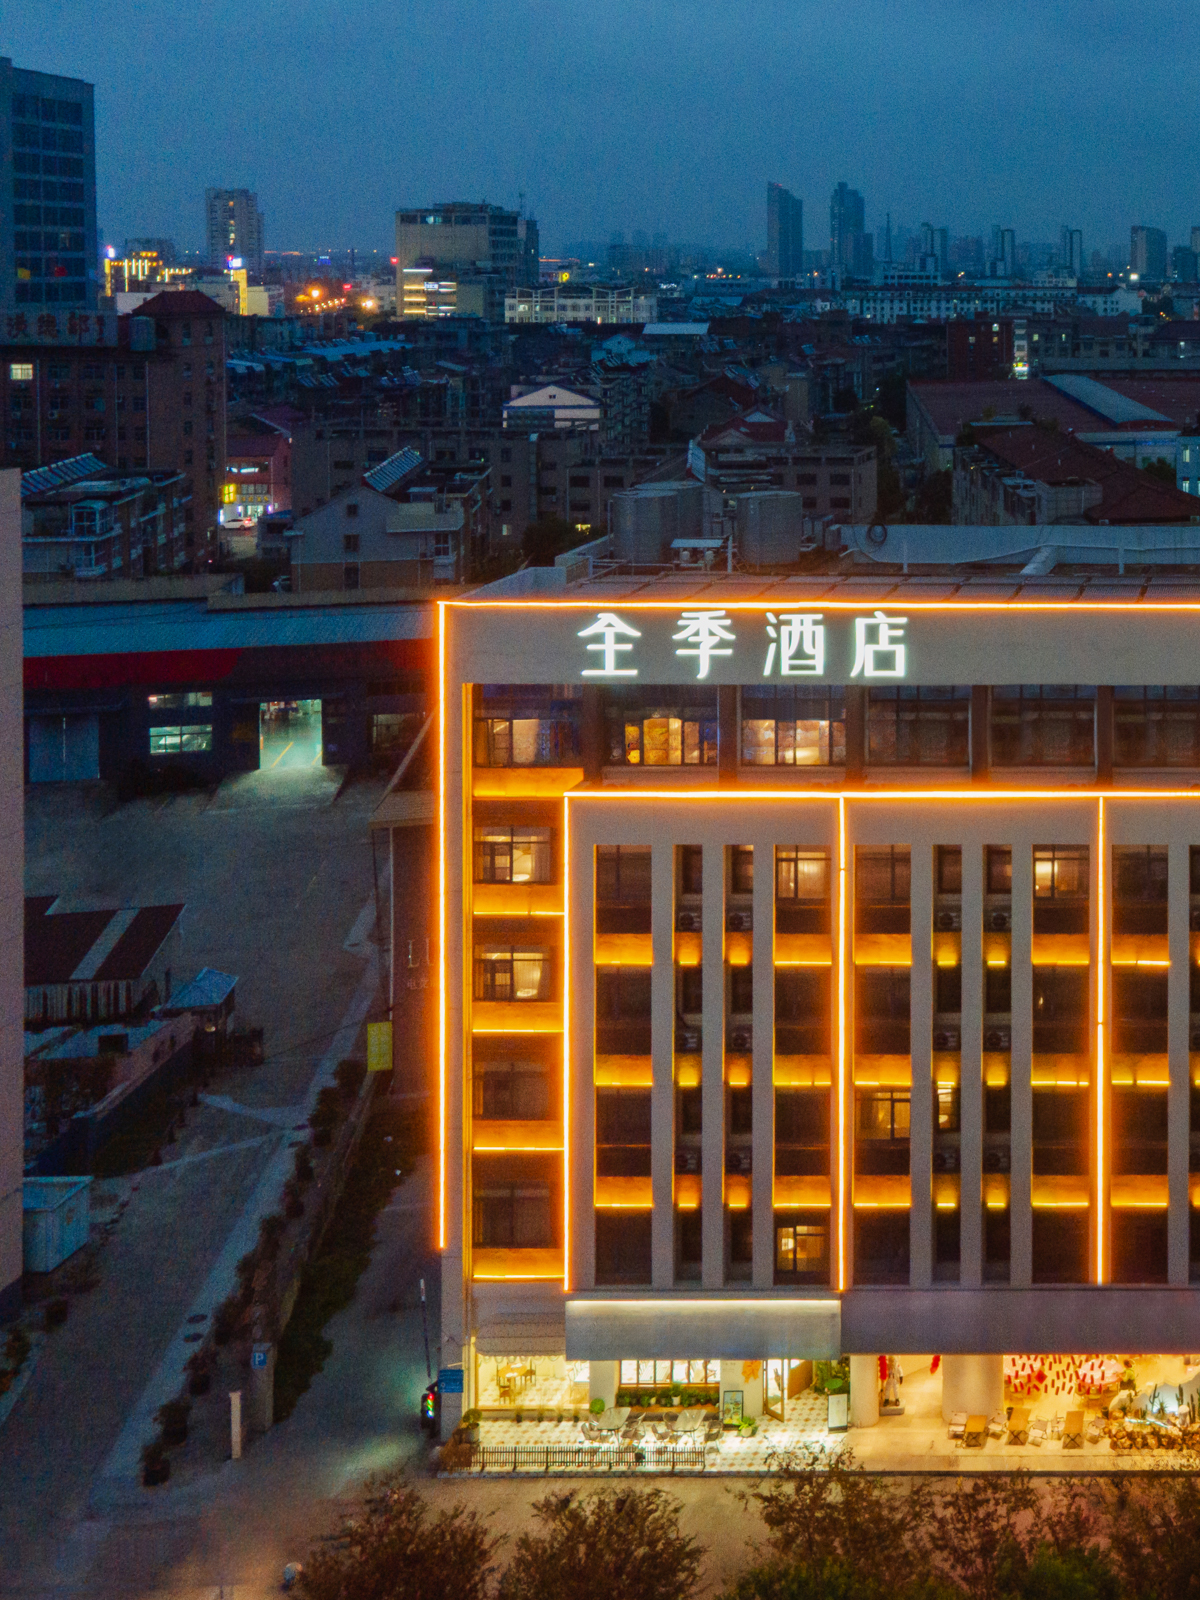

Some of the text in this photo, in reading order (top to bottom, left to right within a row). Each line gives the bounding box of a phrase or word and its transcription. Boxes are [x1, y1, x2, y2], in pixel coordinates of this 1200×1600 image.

[577, 609, 908, 679] 全季酒店
[255, 1352, 264, 1365] P
